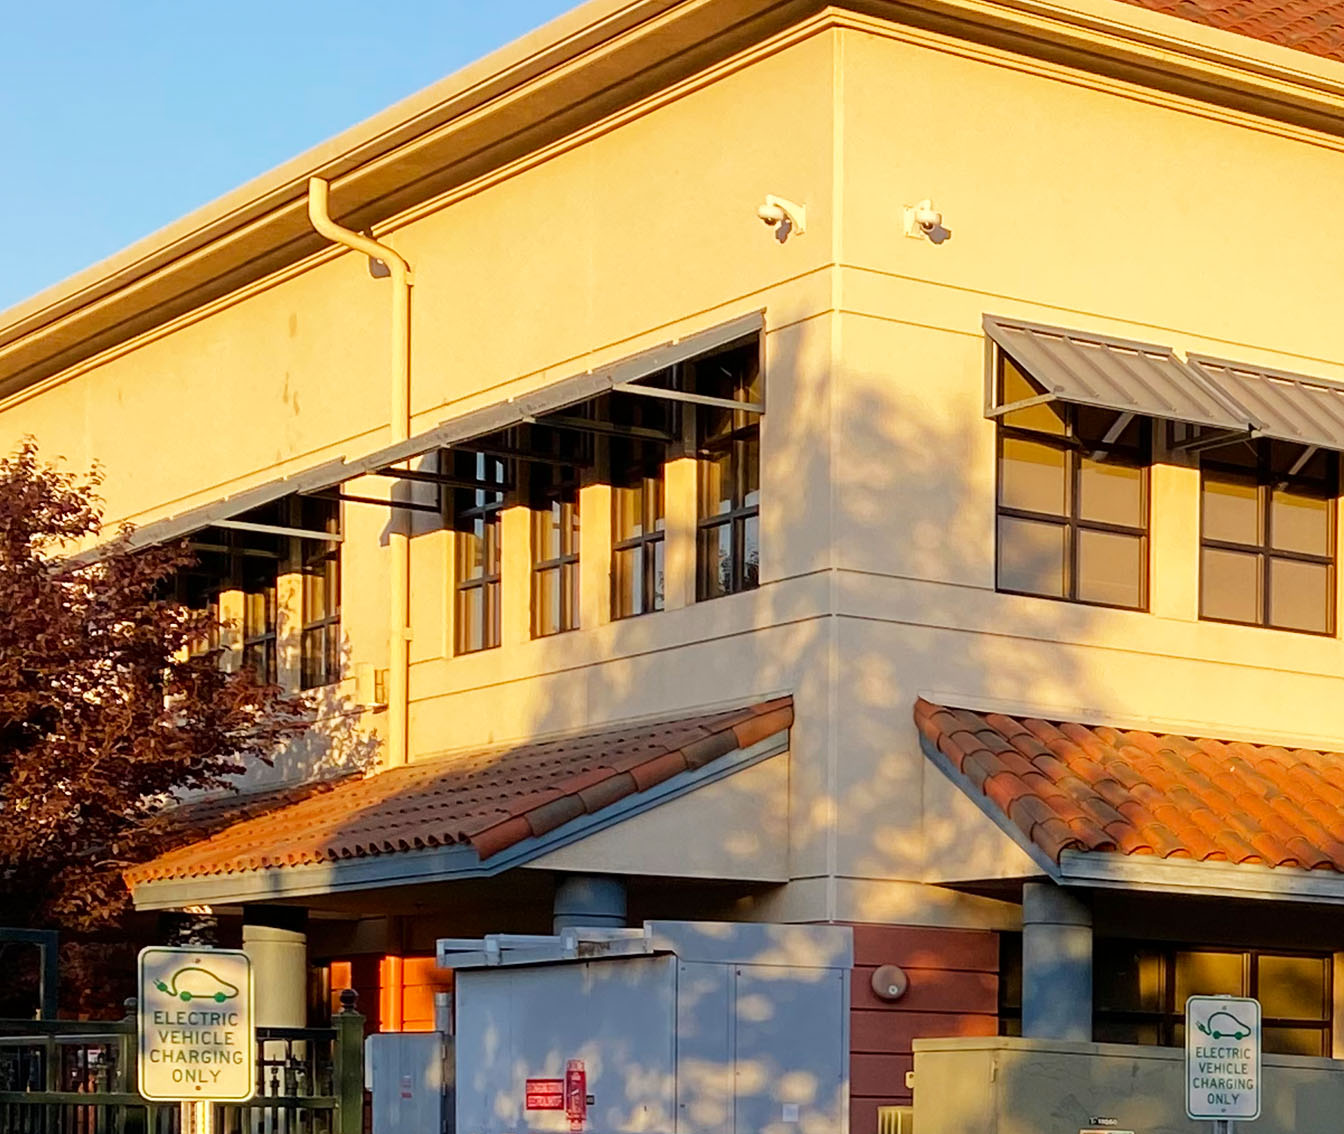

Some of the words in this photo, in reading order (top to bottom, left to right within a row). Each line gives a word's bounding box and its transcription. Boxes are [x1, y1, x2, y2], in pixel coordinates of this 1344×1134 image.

[154, 1011, 238, 1026] ELECTRIC
[159, 1031, 235, 1045] VEHICLE
[150, 1049, 243, 1064] CHARGING
[1196, 1047, 1251, 1059] ELECTRIC
[1199, 1062, 1248, 1074] VEHICLE
[172, 1069, 221, 1083] ONLY
[1193, 1078, 1254, 1090] CHARGING
[1207, 1093, 1239, 1105] ONLY
